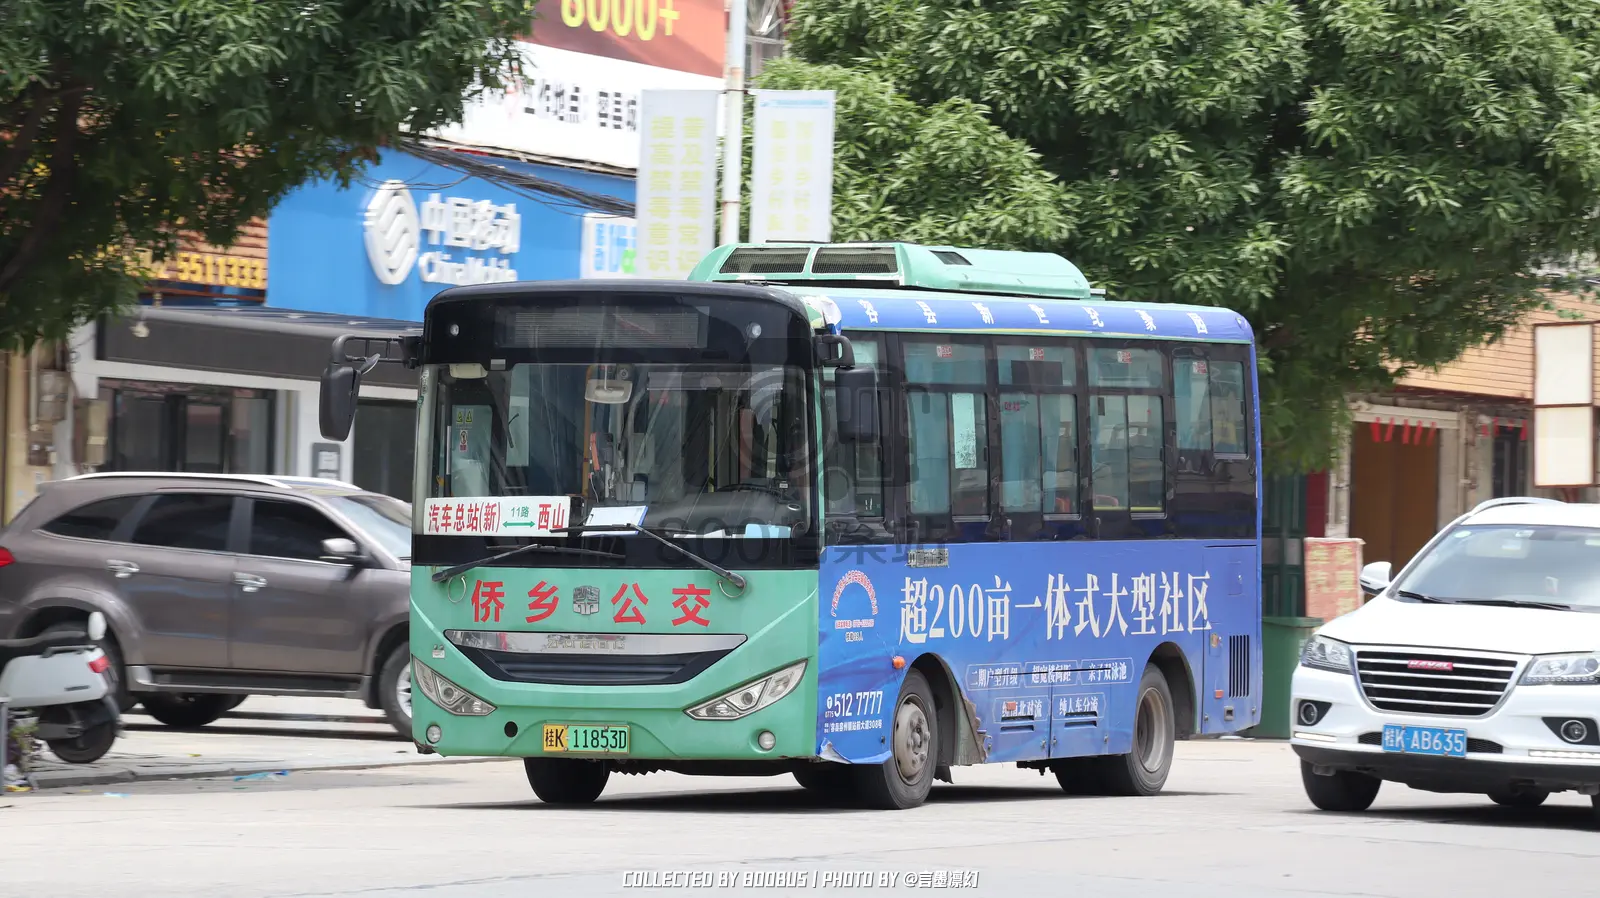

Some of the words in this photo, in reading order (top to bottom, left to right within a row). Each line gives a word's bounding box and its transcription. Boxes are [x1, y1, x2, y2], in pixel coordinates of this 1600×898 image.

[420, 193, 521, 254] 中国移动
[428, 501, 501, 533] 汽车总站(新)
[511, 506, 530, 518] 11路
[537, 502, 565, 531] 西山
[899, 570, 1212, 645] 超200亩一体式大型社区
[856, 690, 884, 716] 7777
